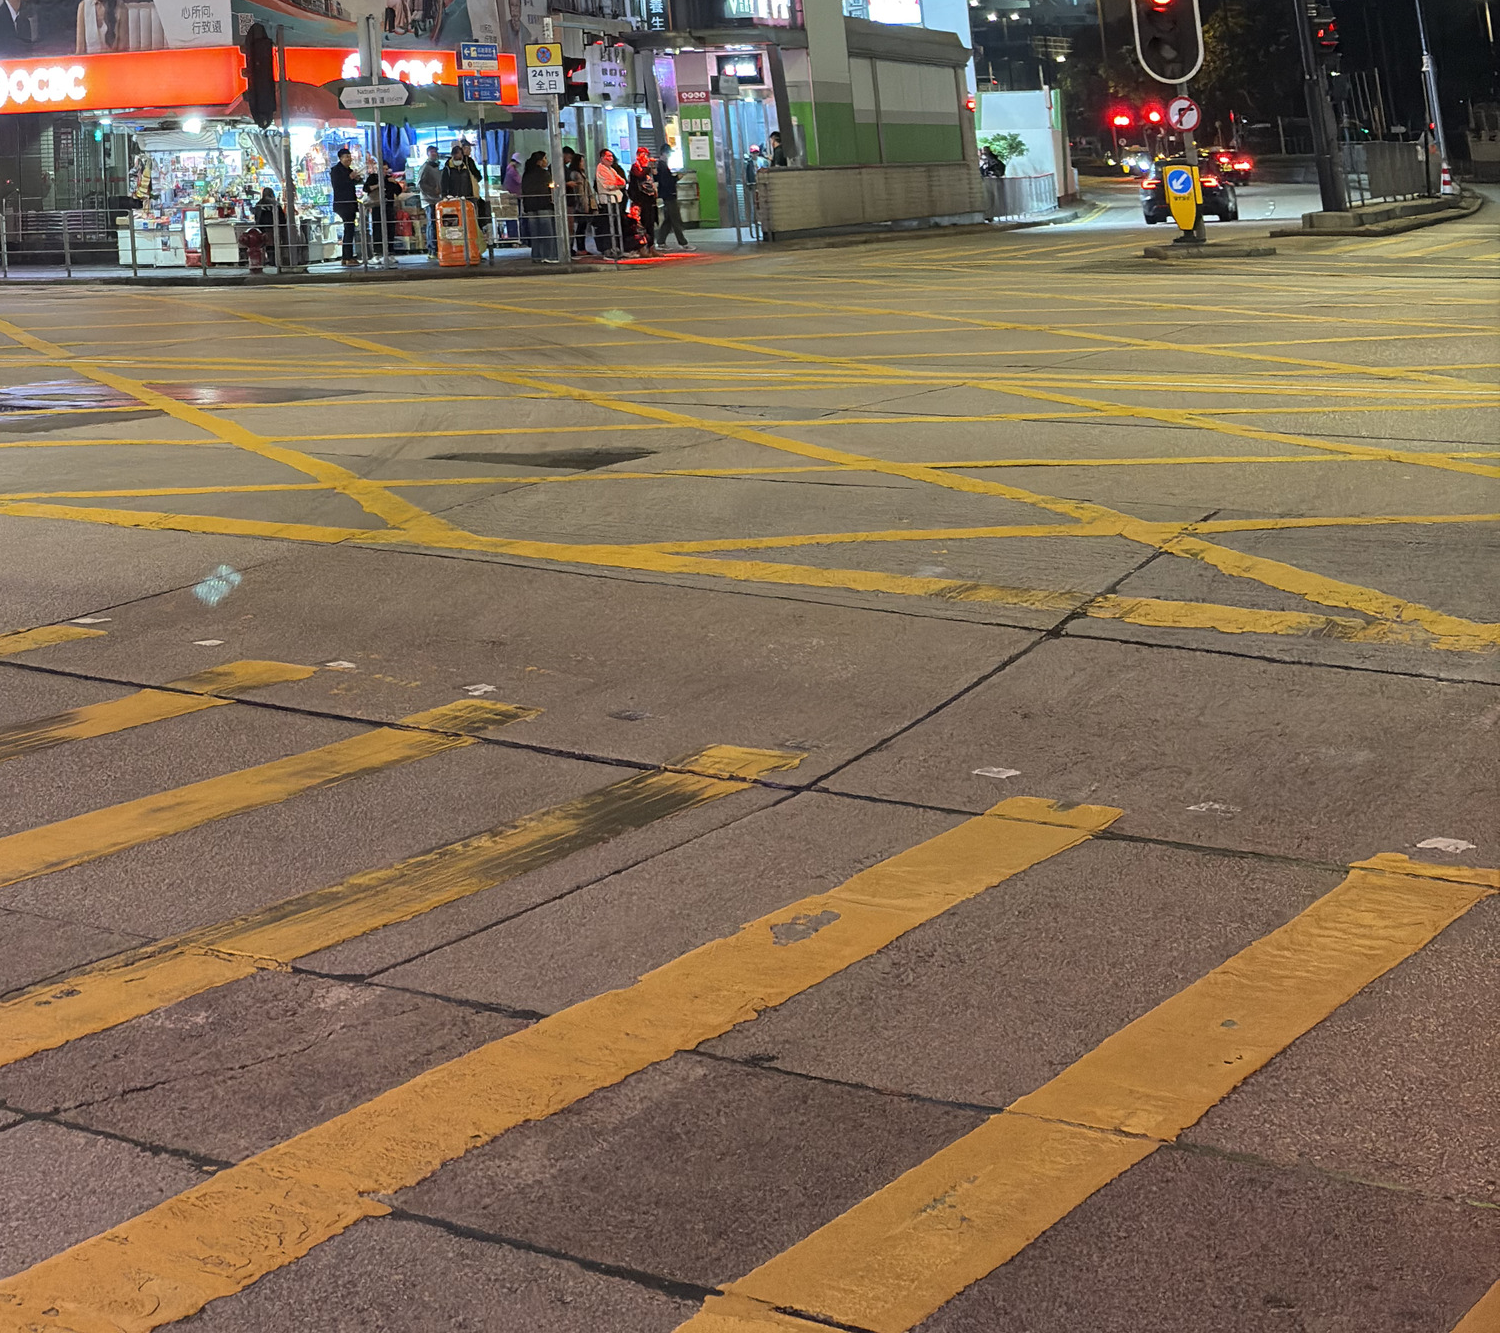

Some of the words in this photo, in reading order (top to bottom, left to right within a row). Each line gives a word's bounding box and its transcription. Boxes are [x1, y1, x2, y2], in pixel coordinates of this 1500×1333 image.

[532, 69, 544, 77] 24
[546, 69, 560, 77] hrs
[8, 65, 87, 104] OCBC
[536, 81, 557, 91] 全日
